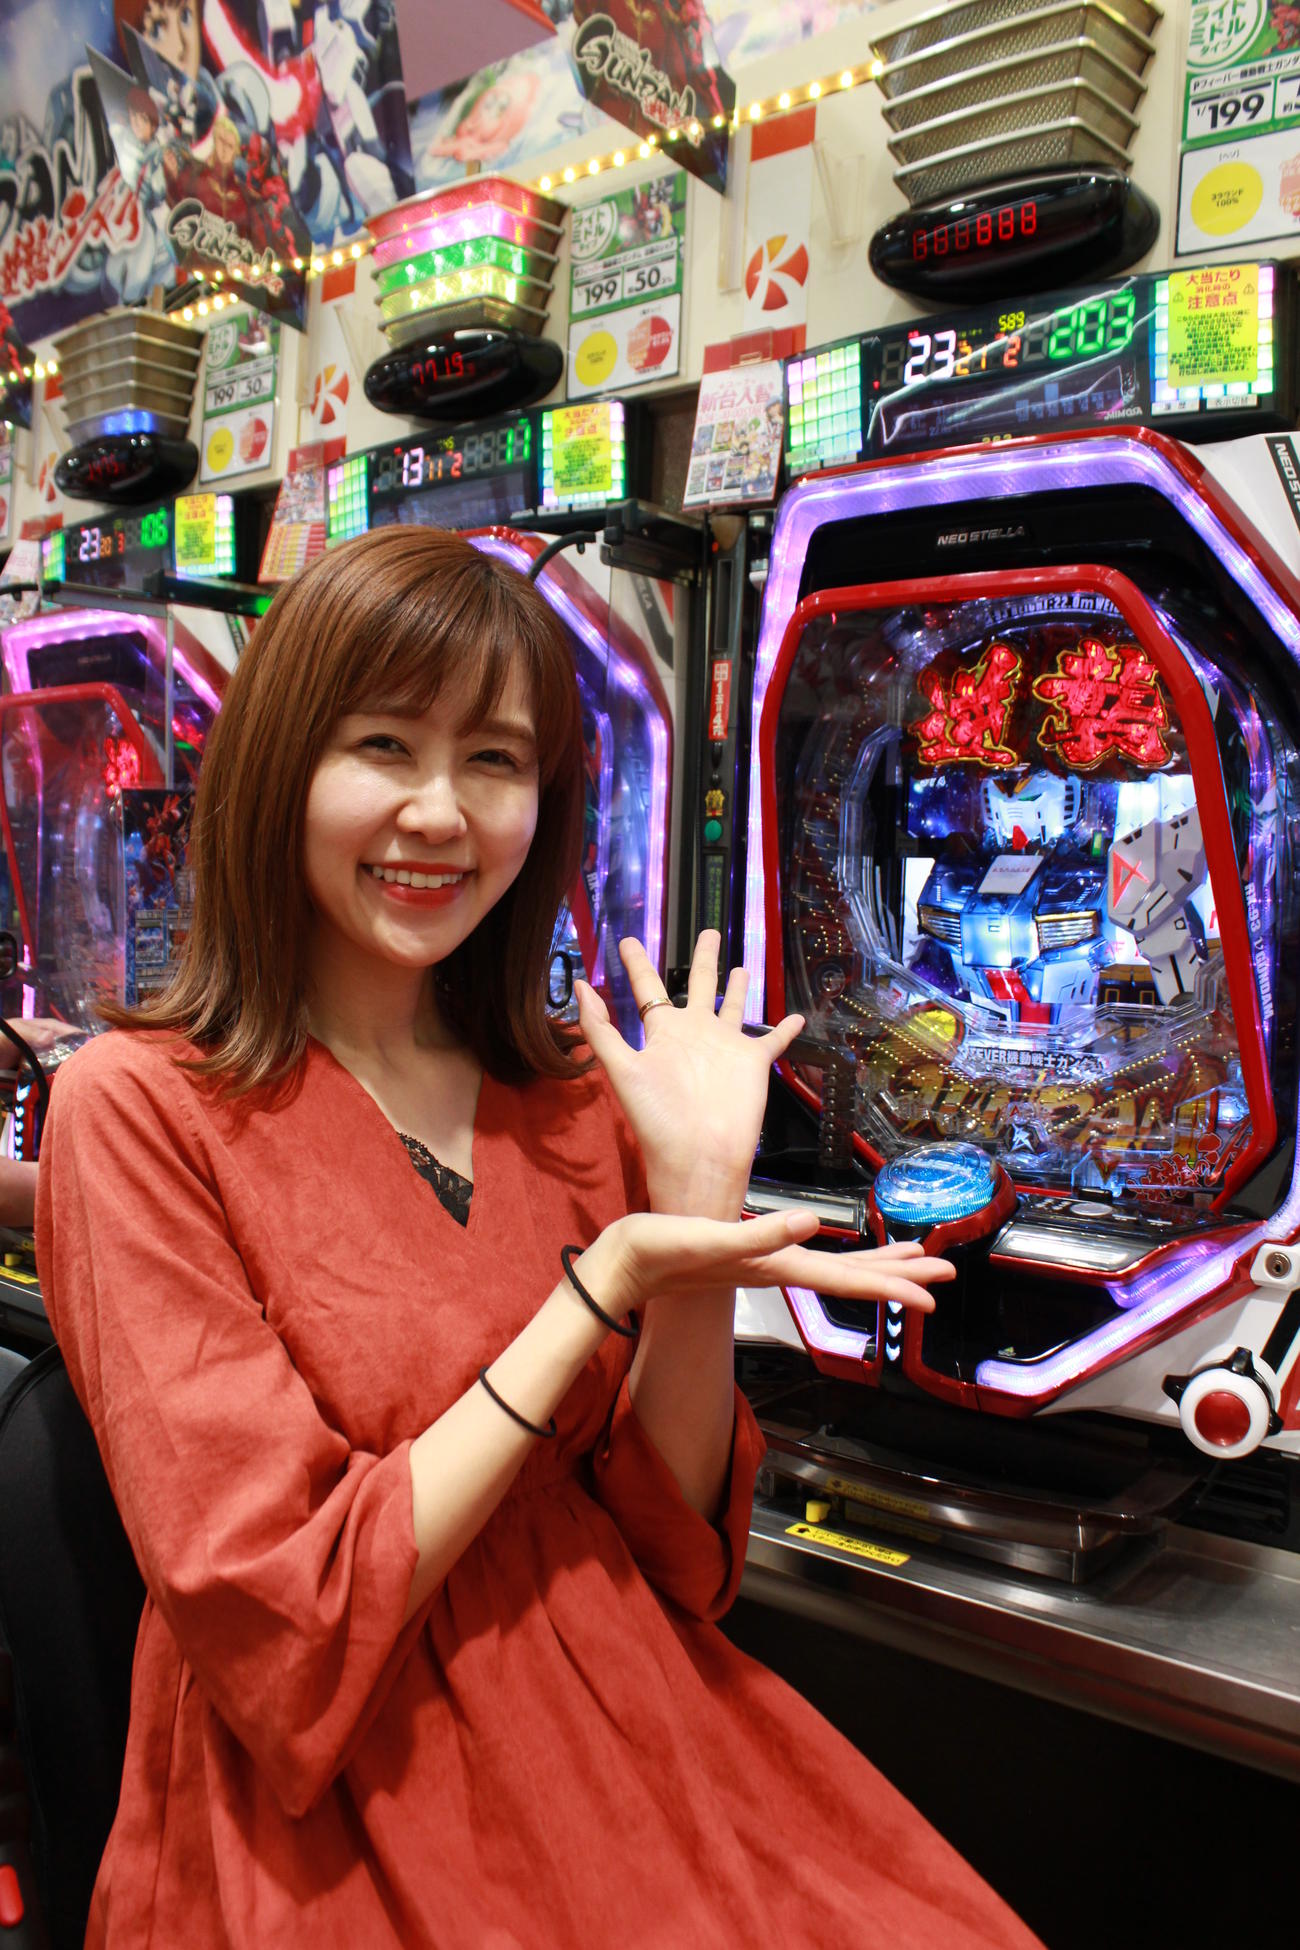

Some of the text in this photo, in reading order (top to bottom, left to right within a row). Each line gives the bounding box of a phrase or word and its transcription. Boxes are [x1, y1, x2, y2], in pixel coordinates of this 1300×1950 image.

[1186, 291, 1238, 311] 注意点
[1048, 294, 1136, 360] 203
[903, 330, 957, 386] 23
[937, 525, 1025, 546] NEO STELLA
